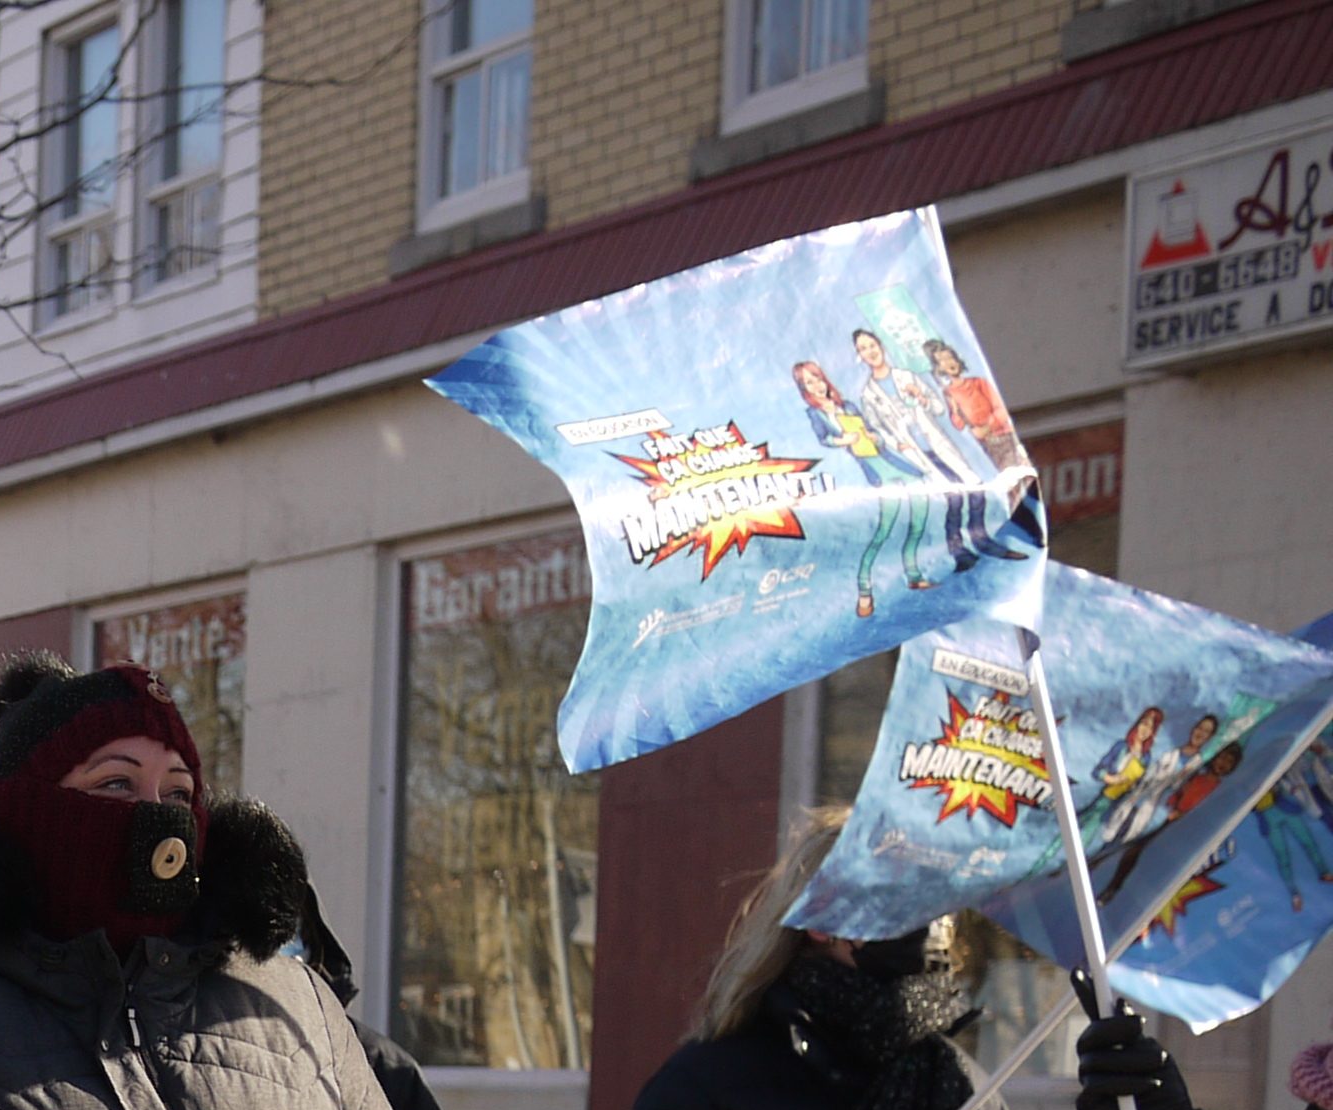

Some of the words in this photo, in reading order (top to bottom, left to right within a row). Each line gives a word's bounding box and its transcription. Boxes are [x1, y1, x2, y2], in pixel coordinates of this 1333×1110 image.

[1135, 300, 1241, 350] SERVICE
[1266, 290, 1281, 325] A
[694, 425, 738, 448] QUE
